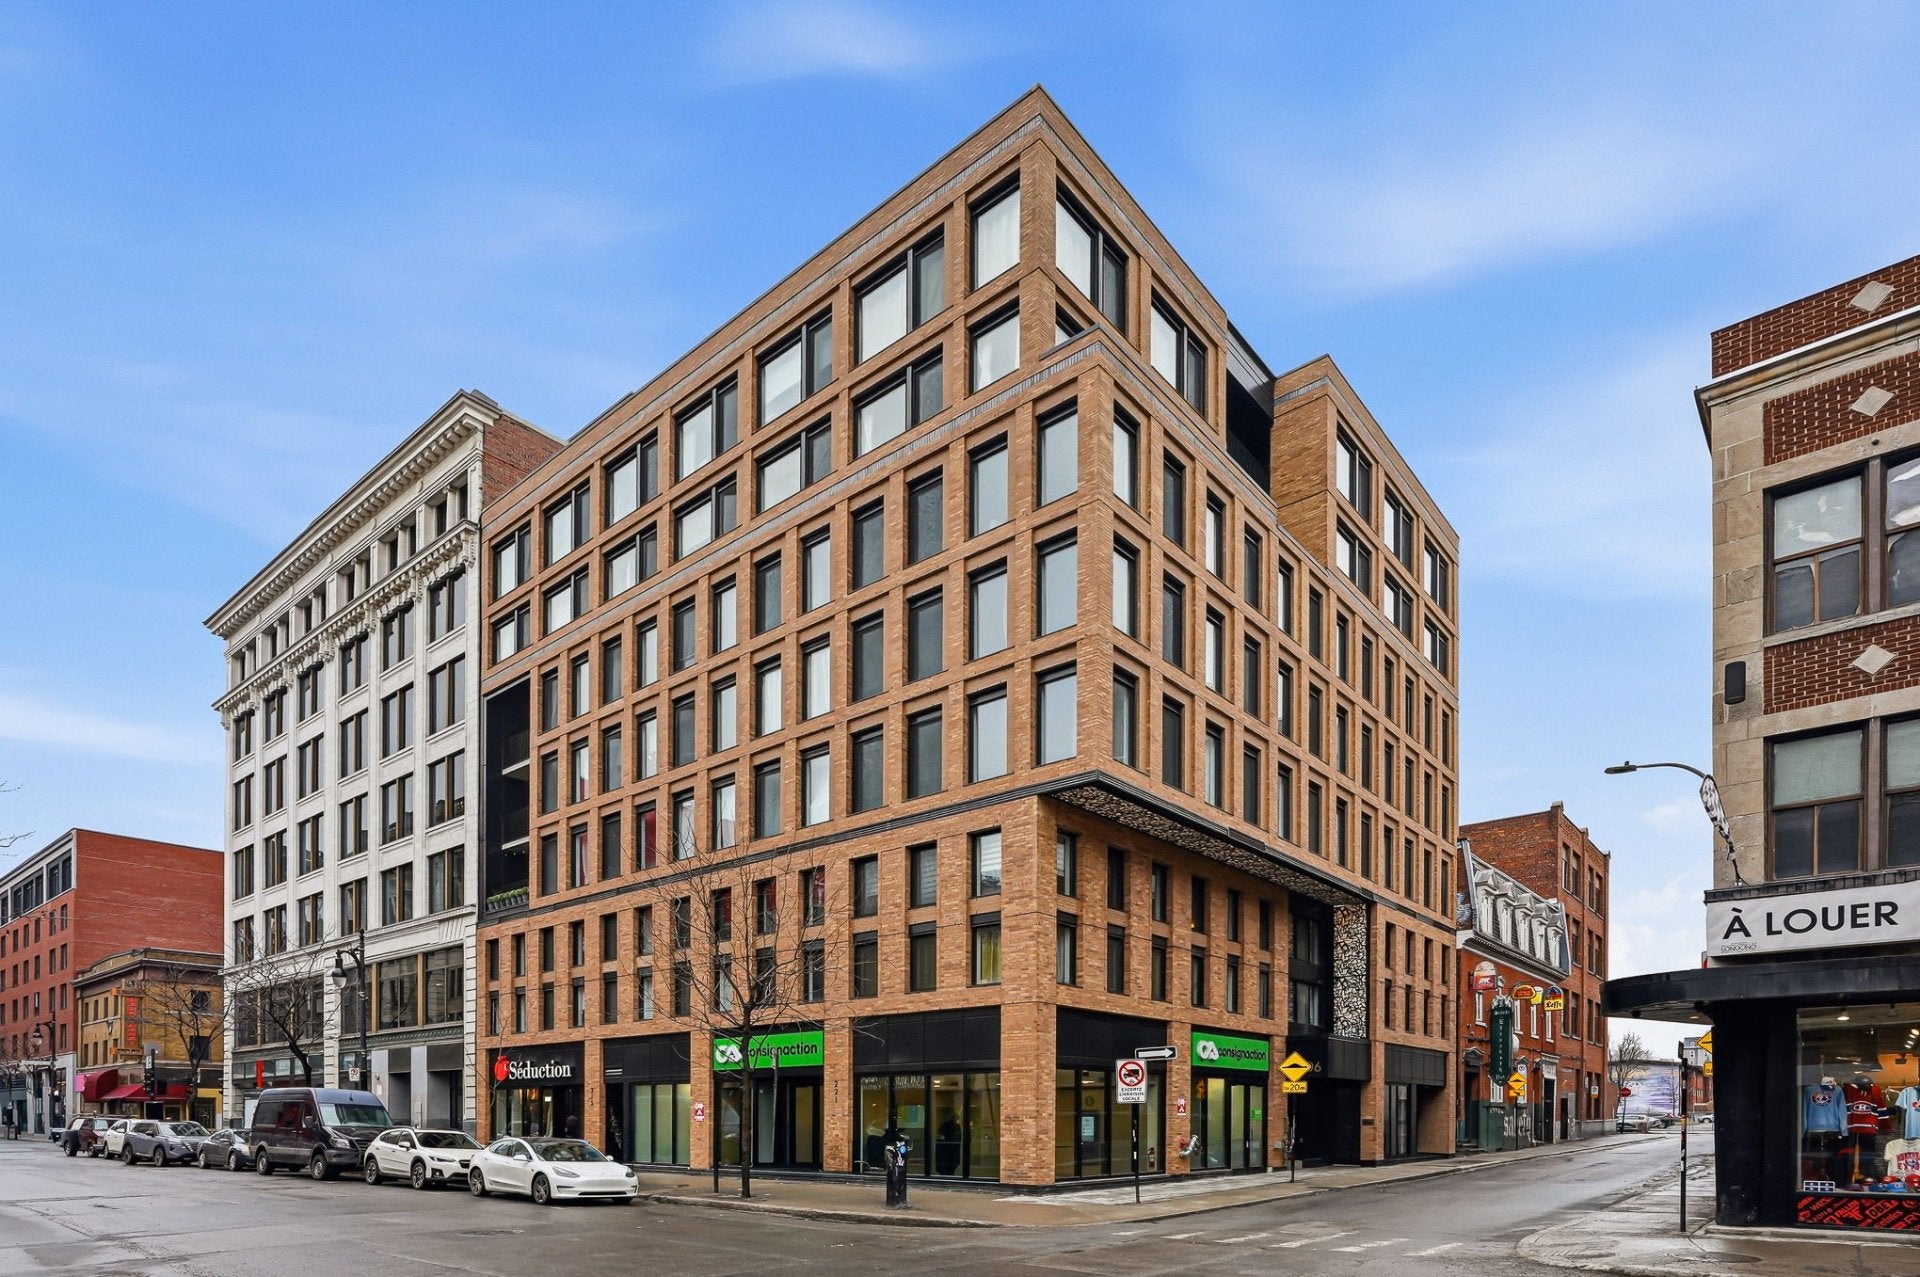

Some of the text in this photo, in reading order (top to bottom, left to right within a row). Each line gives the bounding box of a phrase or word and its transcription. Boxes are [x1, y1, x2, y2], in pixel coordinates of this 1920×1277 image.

[1722, 901, 1899, 939] À LOUER
[508, 1060, 572, 1080] Séduction
[1289, 1083, 1300, 1091] 20
